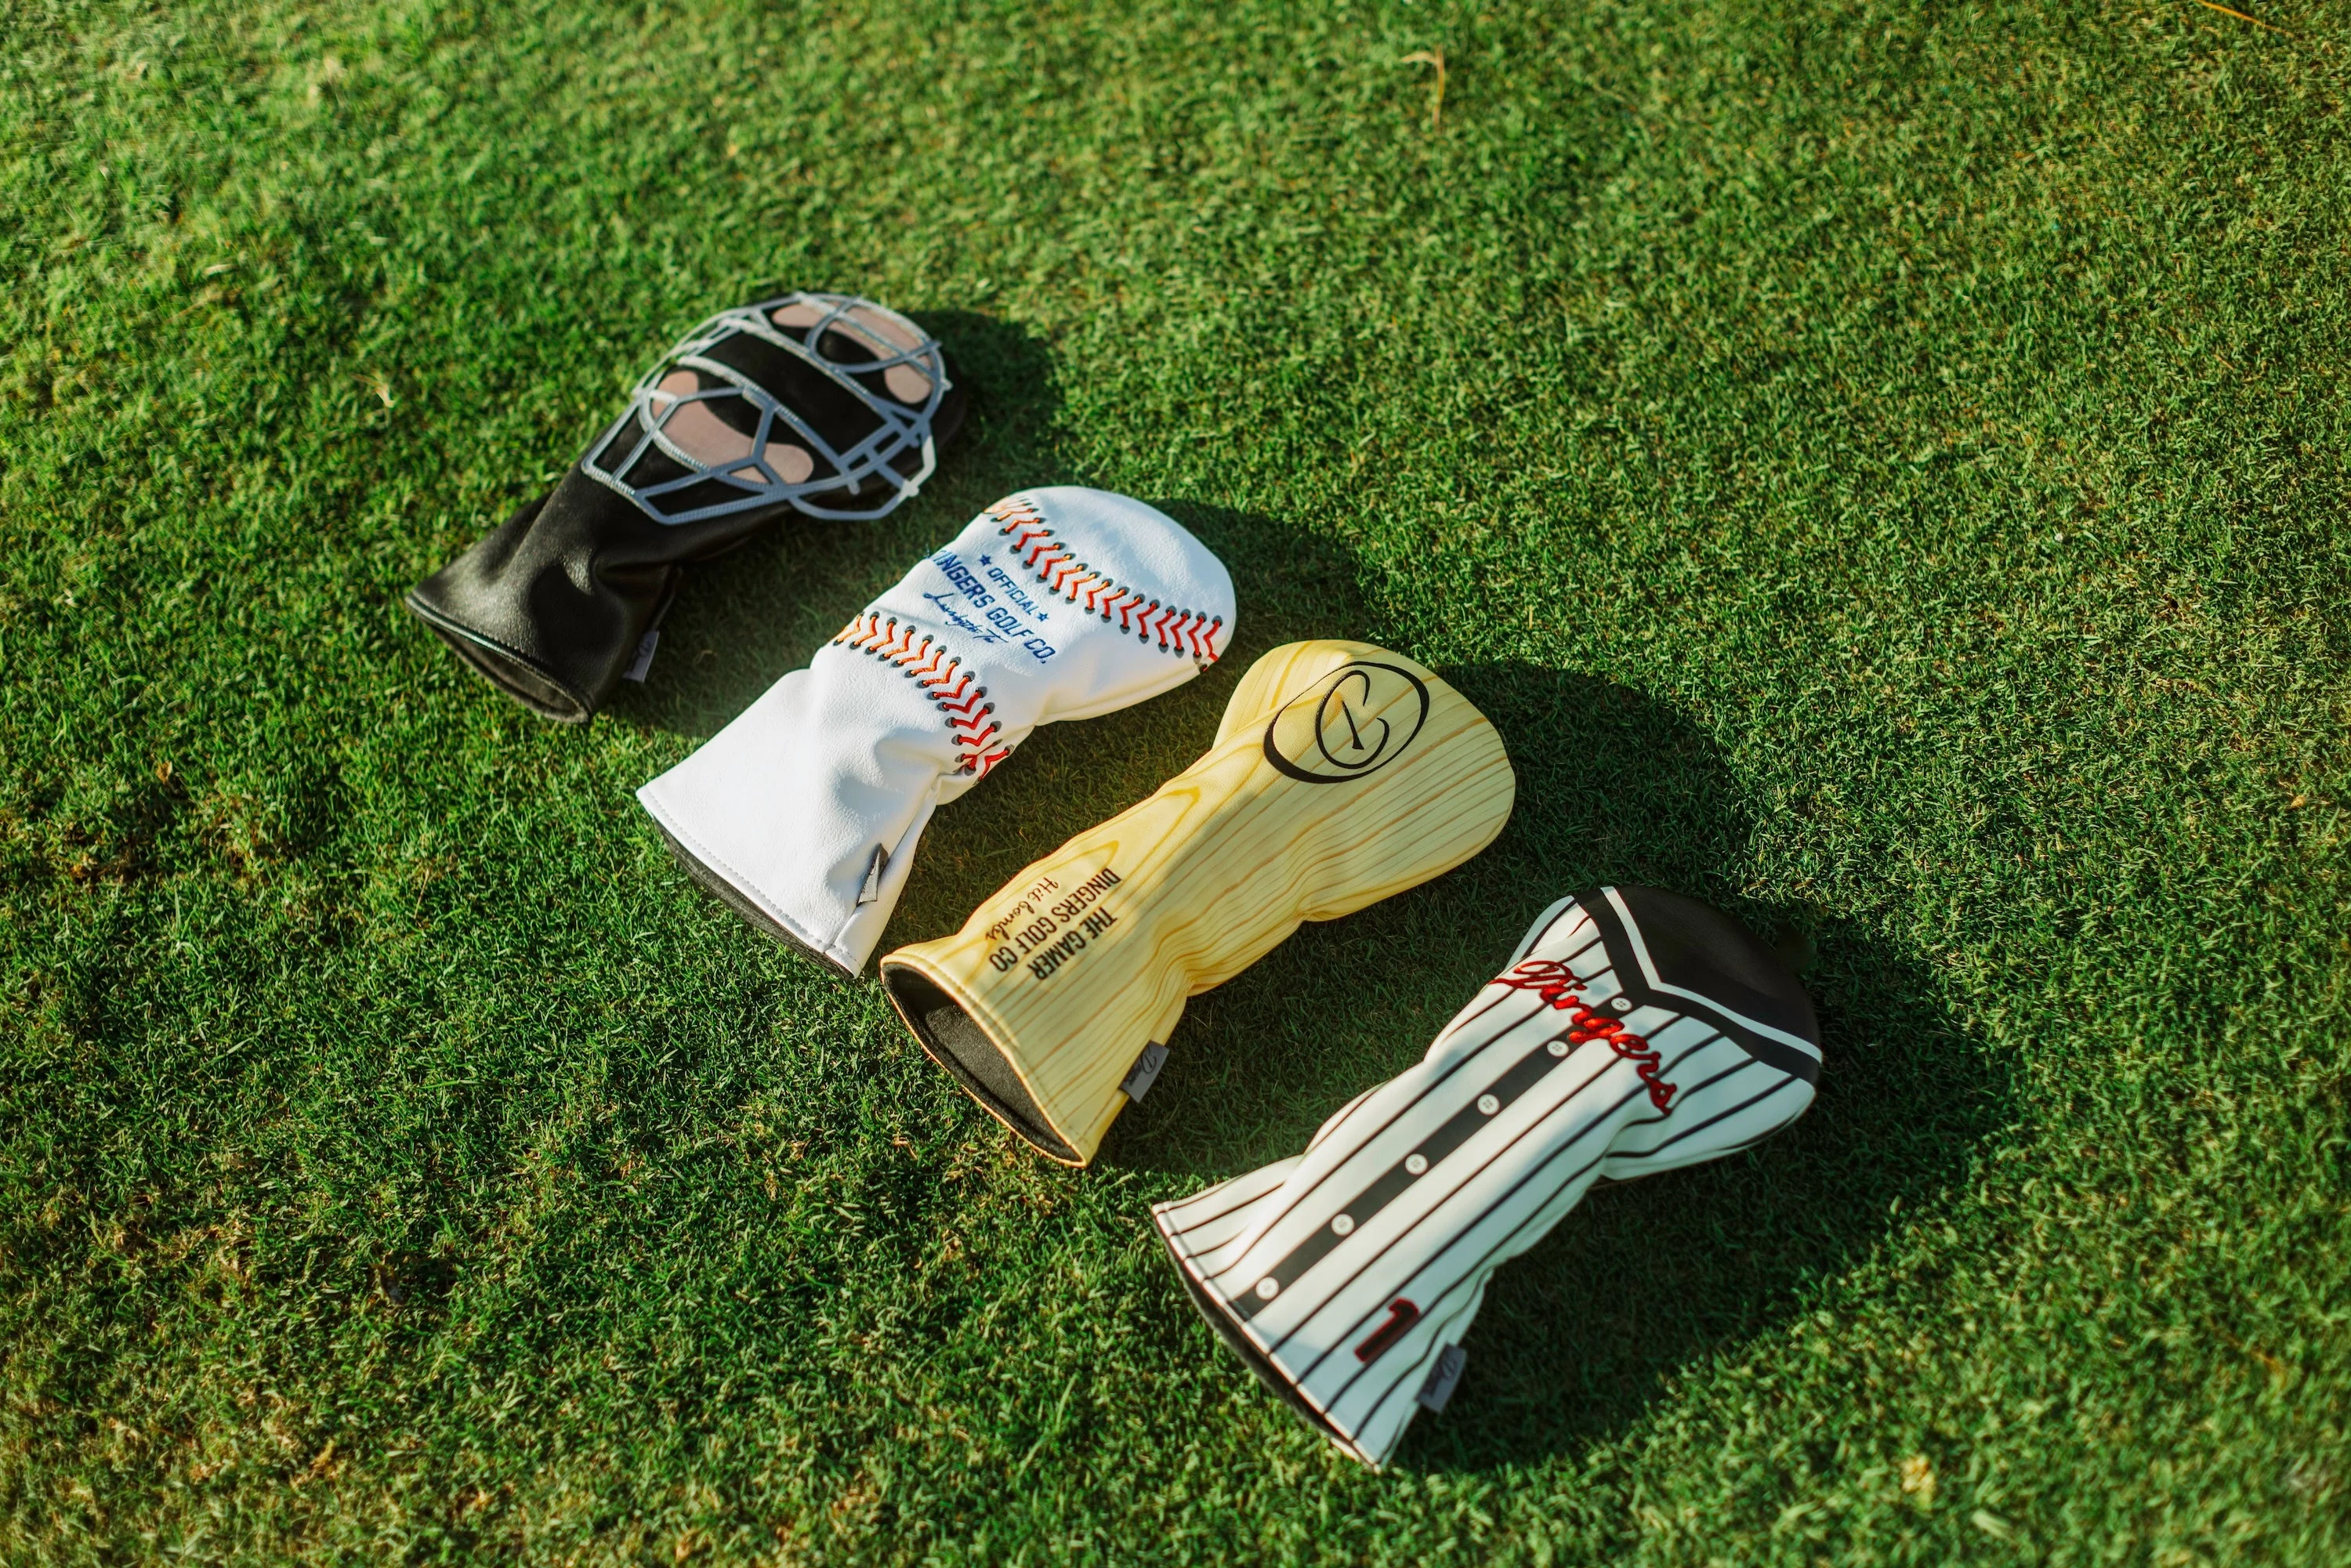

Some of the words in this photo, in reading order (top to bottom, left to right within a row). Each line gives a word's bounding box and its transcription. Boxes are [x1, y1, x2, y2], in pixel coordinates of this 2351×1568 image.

[933, 549, 995, 608] INGERS
[986, 607, 1034, 638] GOLF
[1023, 638, 1056, 664] CO.
[987, 567, 1039, 616] OFFICIAL
[1027, 877, 1059, 902] Hit
[1051, 867, 1121, 922] DINGERS
[985, 900, 1035, 940] bombs
[1015, 916, 1057, 954] GOLF
[1079, 906, 1118, 940] THE
[989, 946, 1018, 972] CO
[1027, 930, 1086, 980] GAMER
[1488, 961, 1677, 1116] Dingers
[1353, 1297, 1420, 1363] 1
